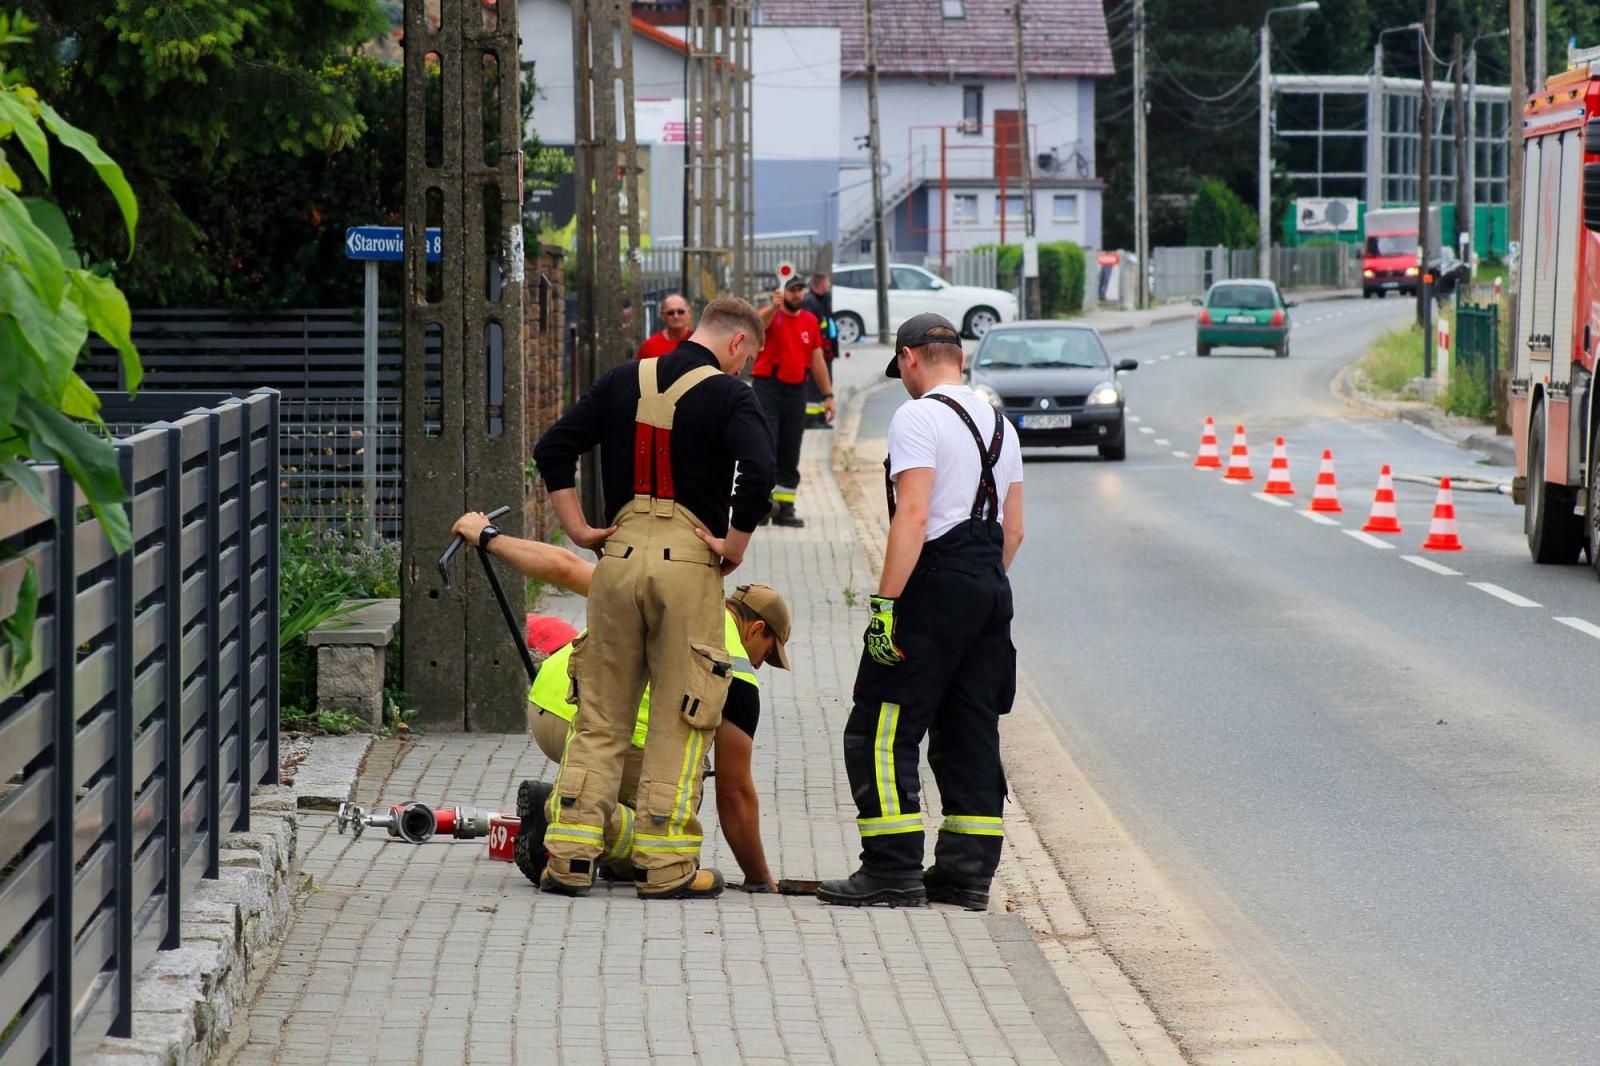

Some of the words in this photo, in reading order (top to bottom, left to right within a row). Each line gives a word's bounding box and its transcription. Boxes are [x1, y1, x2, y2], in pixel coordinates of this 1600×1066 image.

[354, 233, 430, 252] Starowiea
[433, 236, 441, 254] 8
[490, 825, 515, 850] 69
